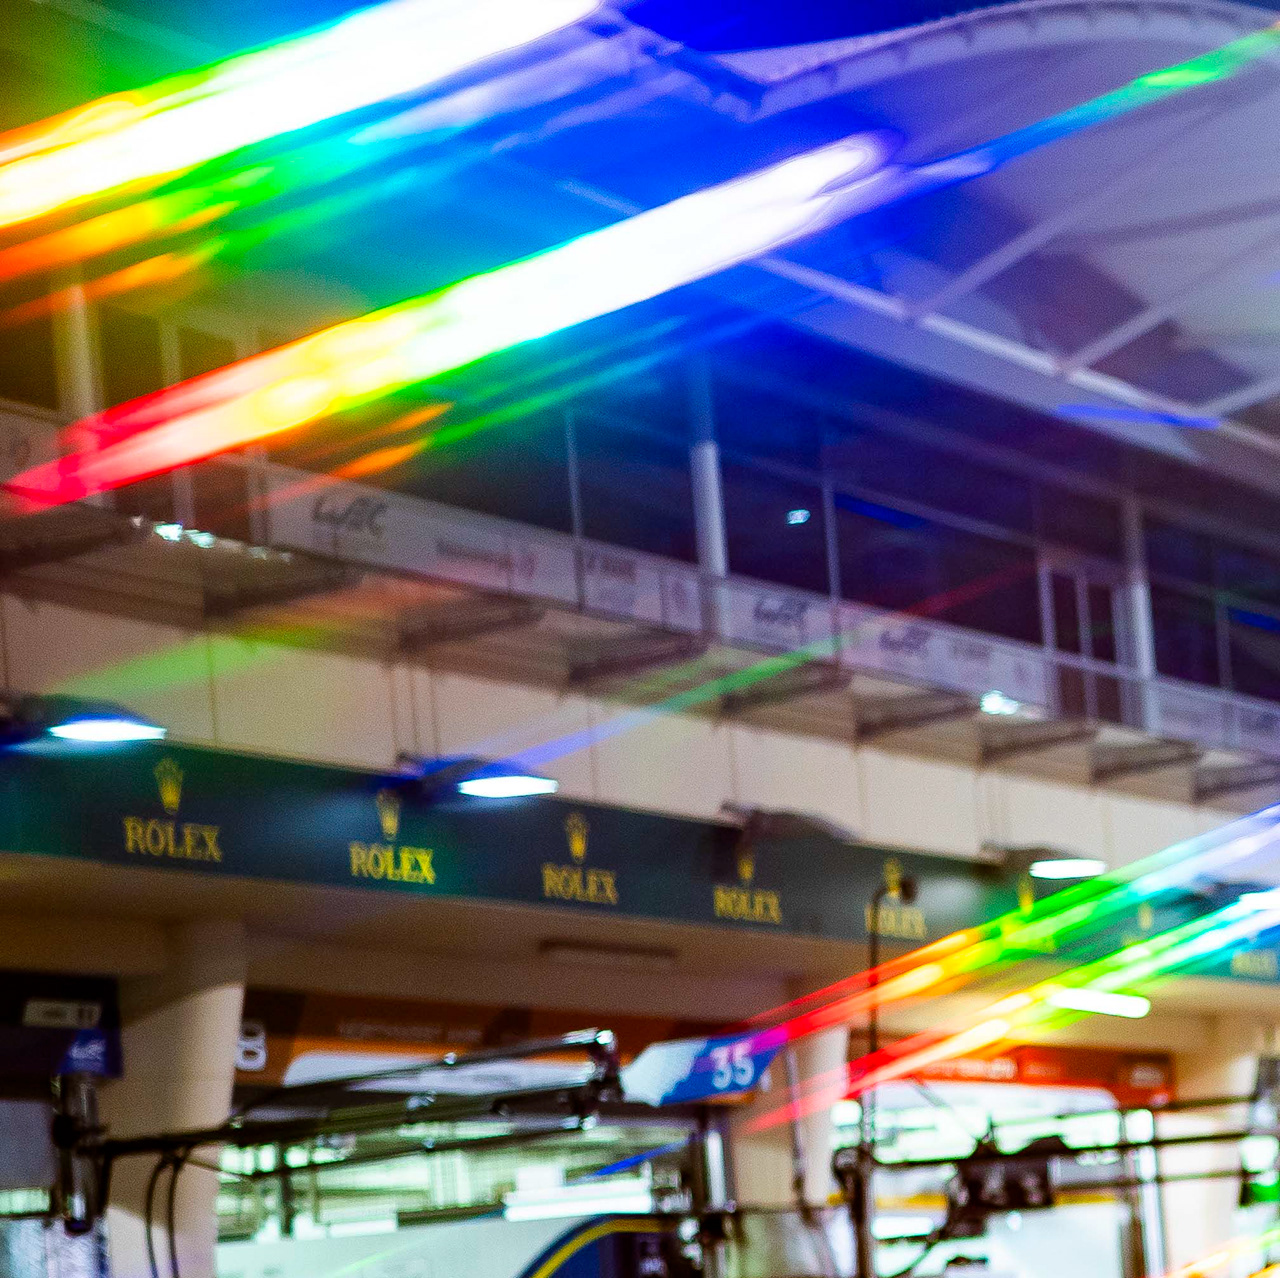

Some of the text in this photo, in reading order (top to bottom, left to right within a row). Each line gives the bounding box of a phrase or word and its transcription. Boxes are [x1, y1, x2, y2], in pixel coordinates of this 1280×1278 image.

[124, 816, 222, 862] ROLEX
[350, 841, 436, 885] ROLEX
[542, 863, 618, 904] ROLEX
[709, 1042, 756, 1090] 35
